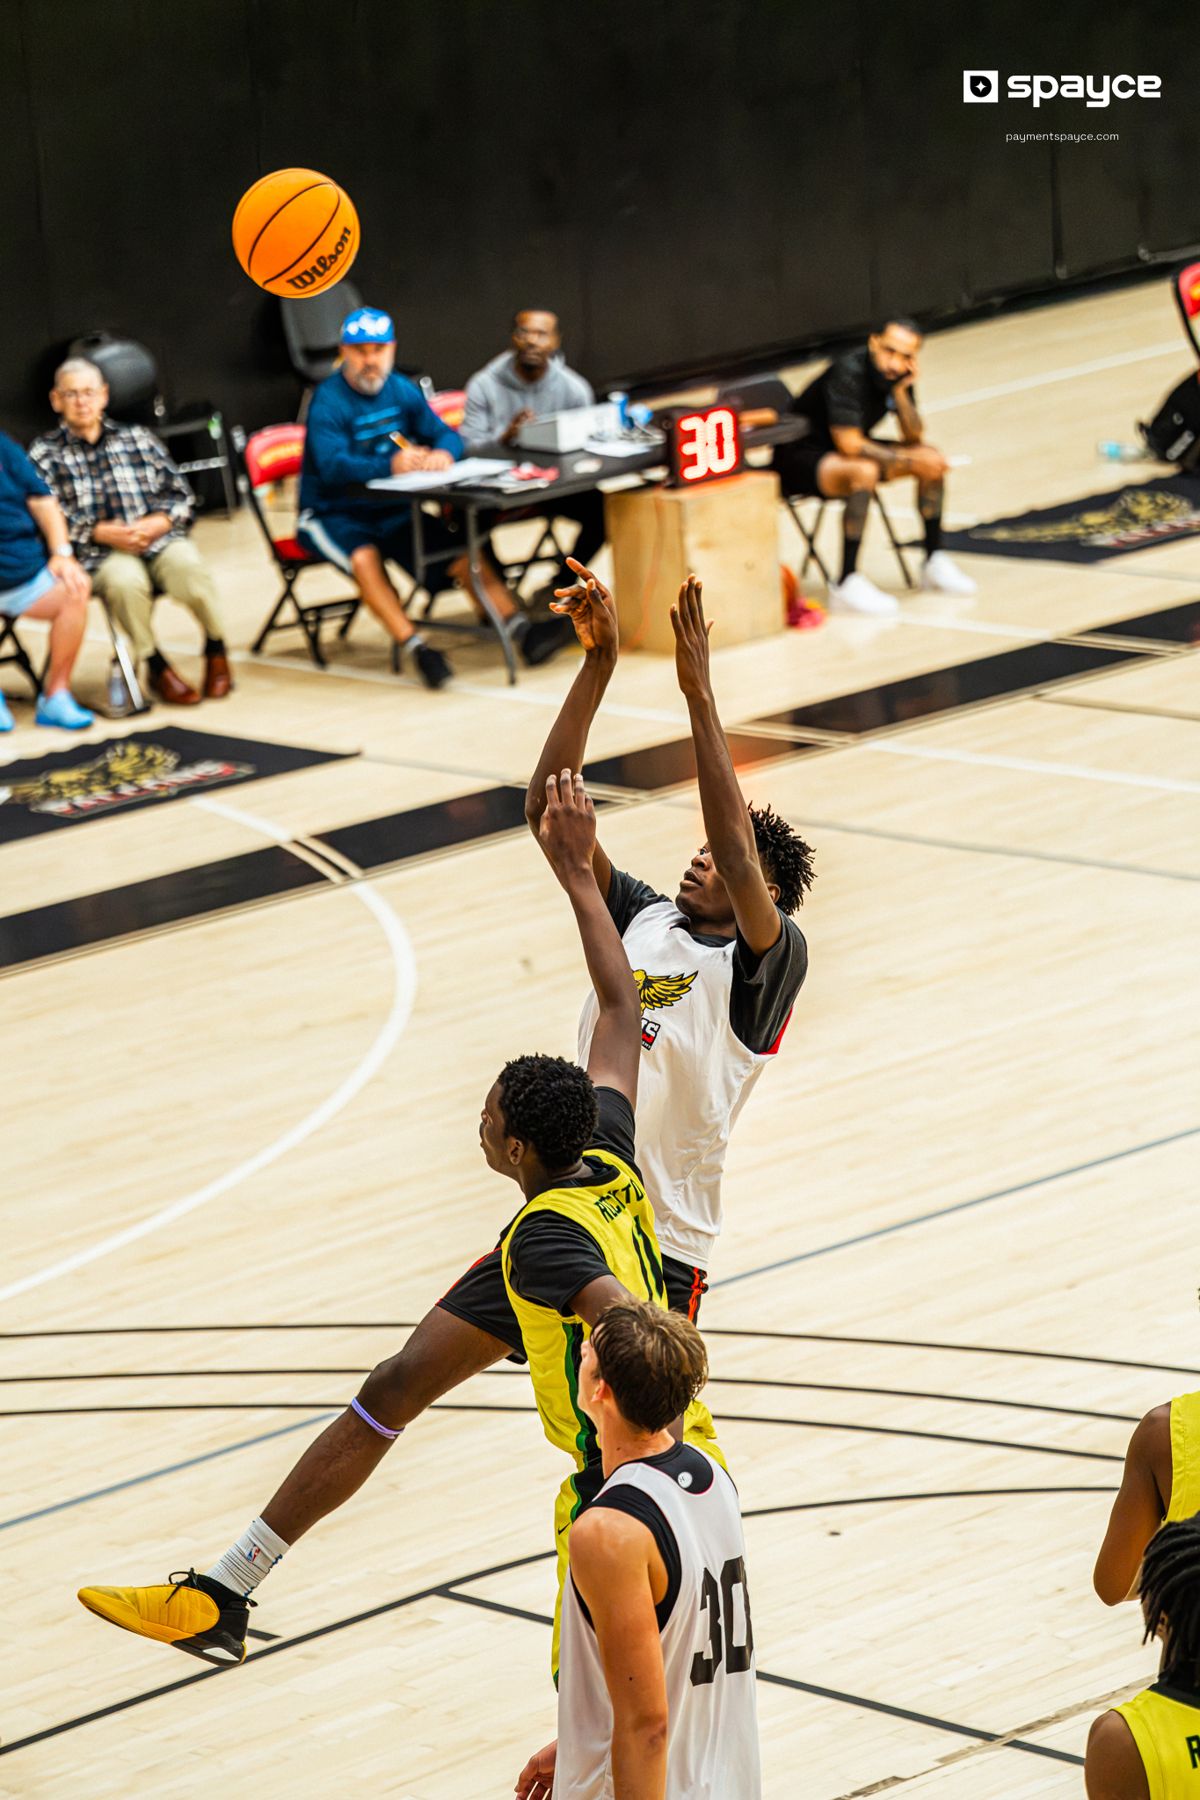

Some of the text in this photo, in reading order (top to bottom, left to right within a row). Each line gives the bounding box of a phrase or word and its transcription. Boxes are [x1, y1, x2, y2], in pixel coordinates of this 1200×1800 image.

[286, 227, 351, 290] Wilson
[680, 409, 737, 480] 30
[690, 1555, 755, 1687] 30
